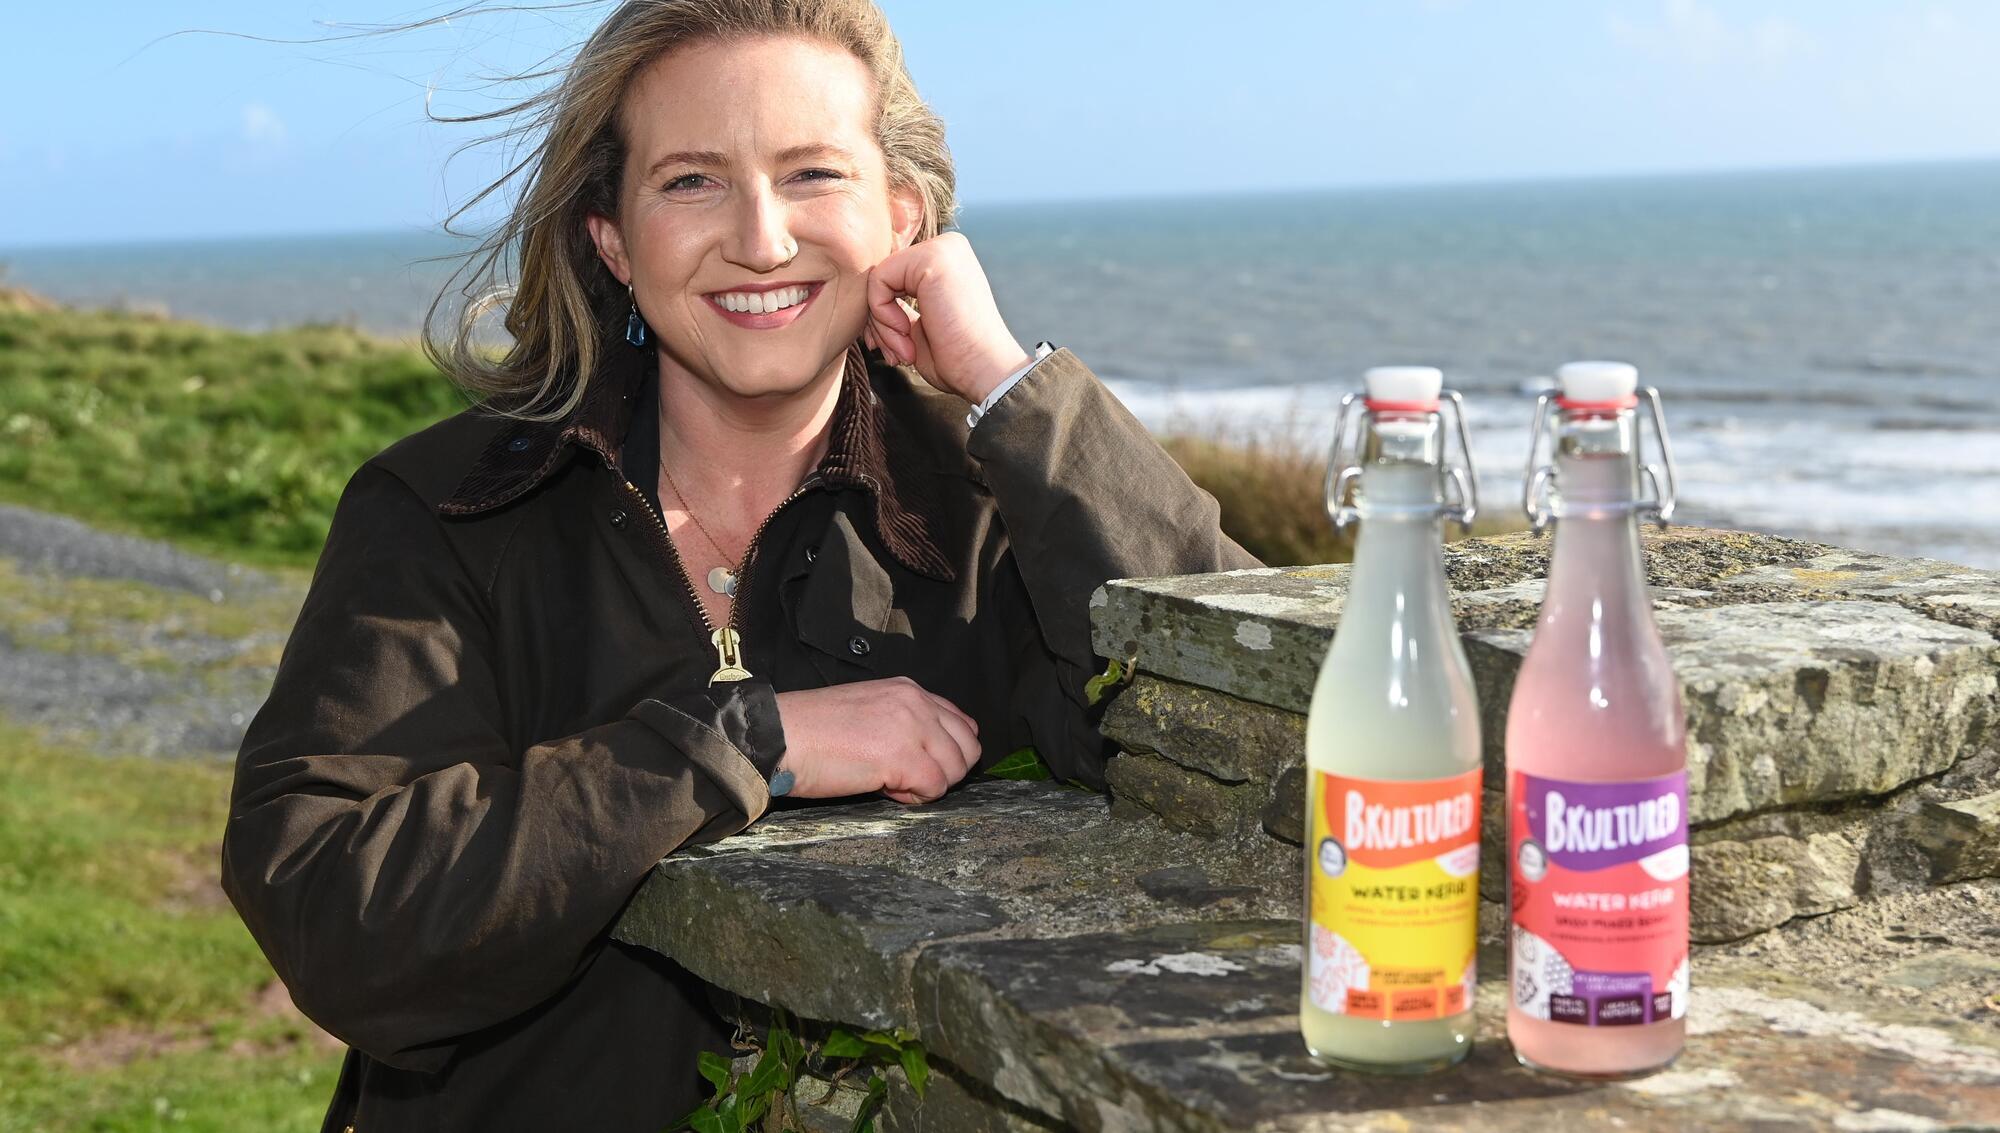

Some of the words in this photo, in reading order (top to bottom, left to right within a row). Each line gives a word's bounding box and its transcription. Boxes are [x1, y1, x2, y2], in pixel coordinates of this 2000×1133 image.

[1345, 790, 1474, 850] BKULTURED
[1545, 791, 1680, 853] BKULTURED
[1352, 885, 1419, 901] WATER
[1552, 891, 1627, 912] WATER
